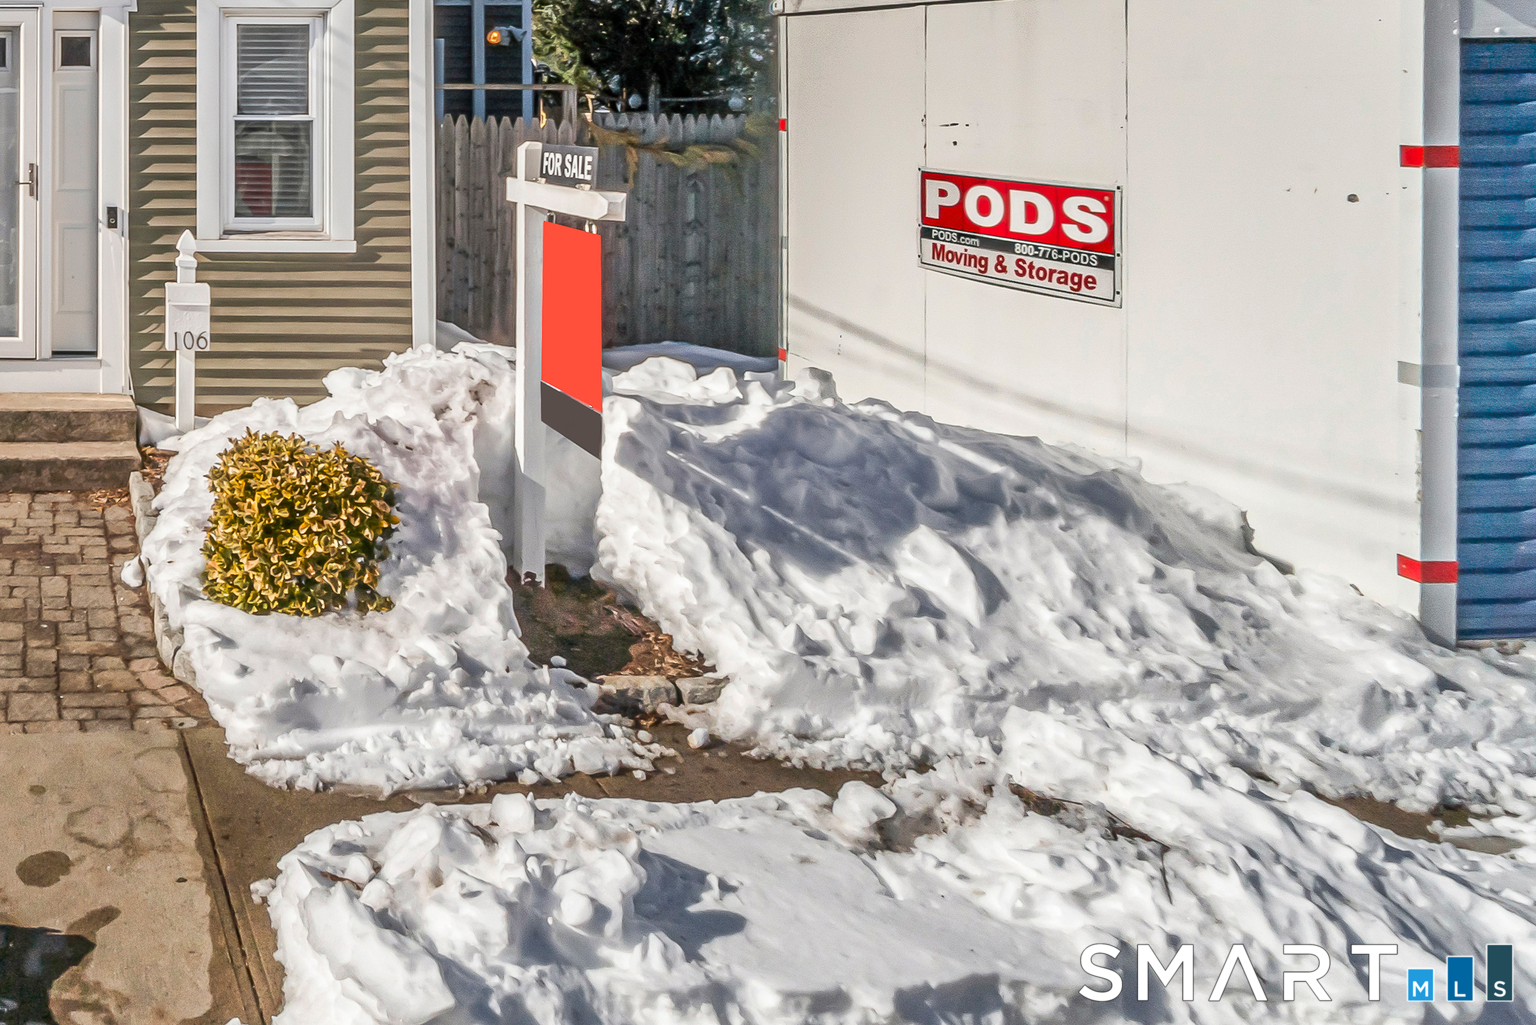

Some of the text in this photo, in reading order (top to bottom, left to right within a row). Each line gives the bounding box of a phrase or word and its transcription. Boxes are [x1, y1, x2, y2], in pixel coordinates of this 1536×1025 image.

[542, 152, 593, 180] FOR SALE
[925, 179, 1109, 243] PODS
[931, 229, 1098, 266] PODS.com 800-776-PODS
[931, 242, 1097, 292] Moving & Storage
[174, 331, 208, 350] 106
